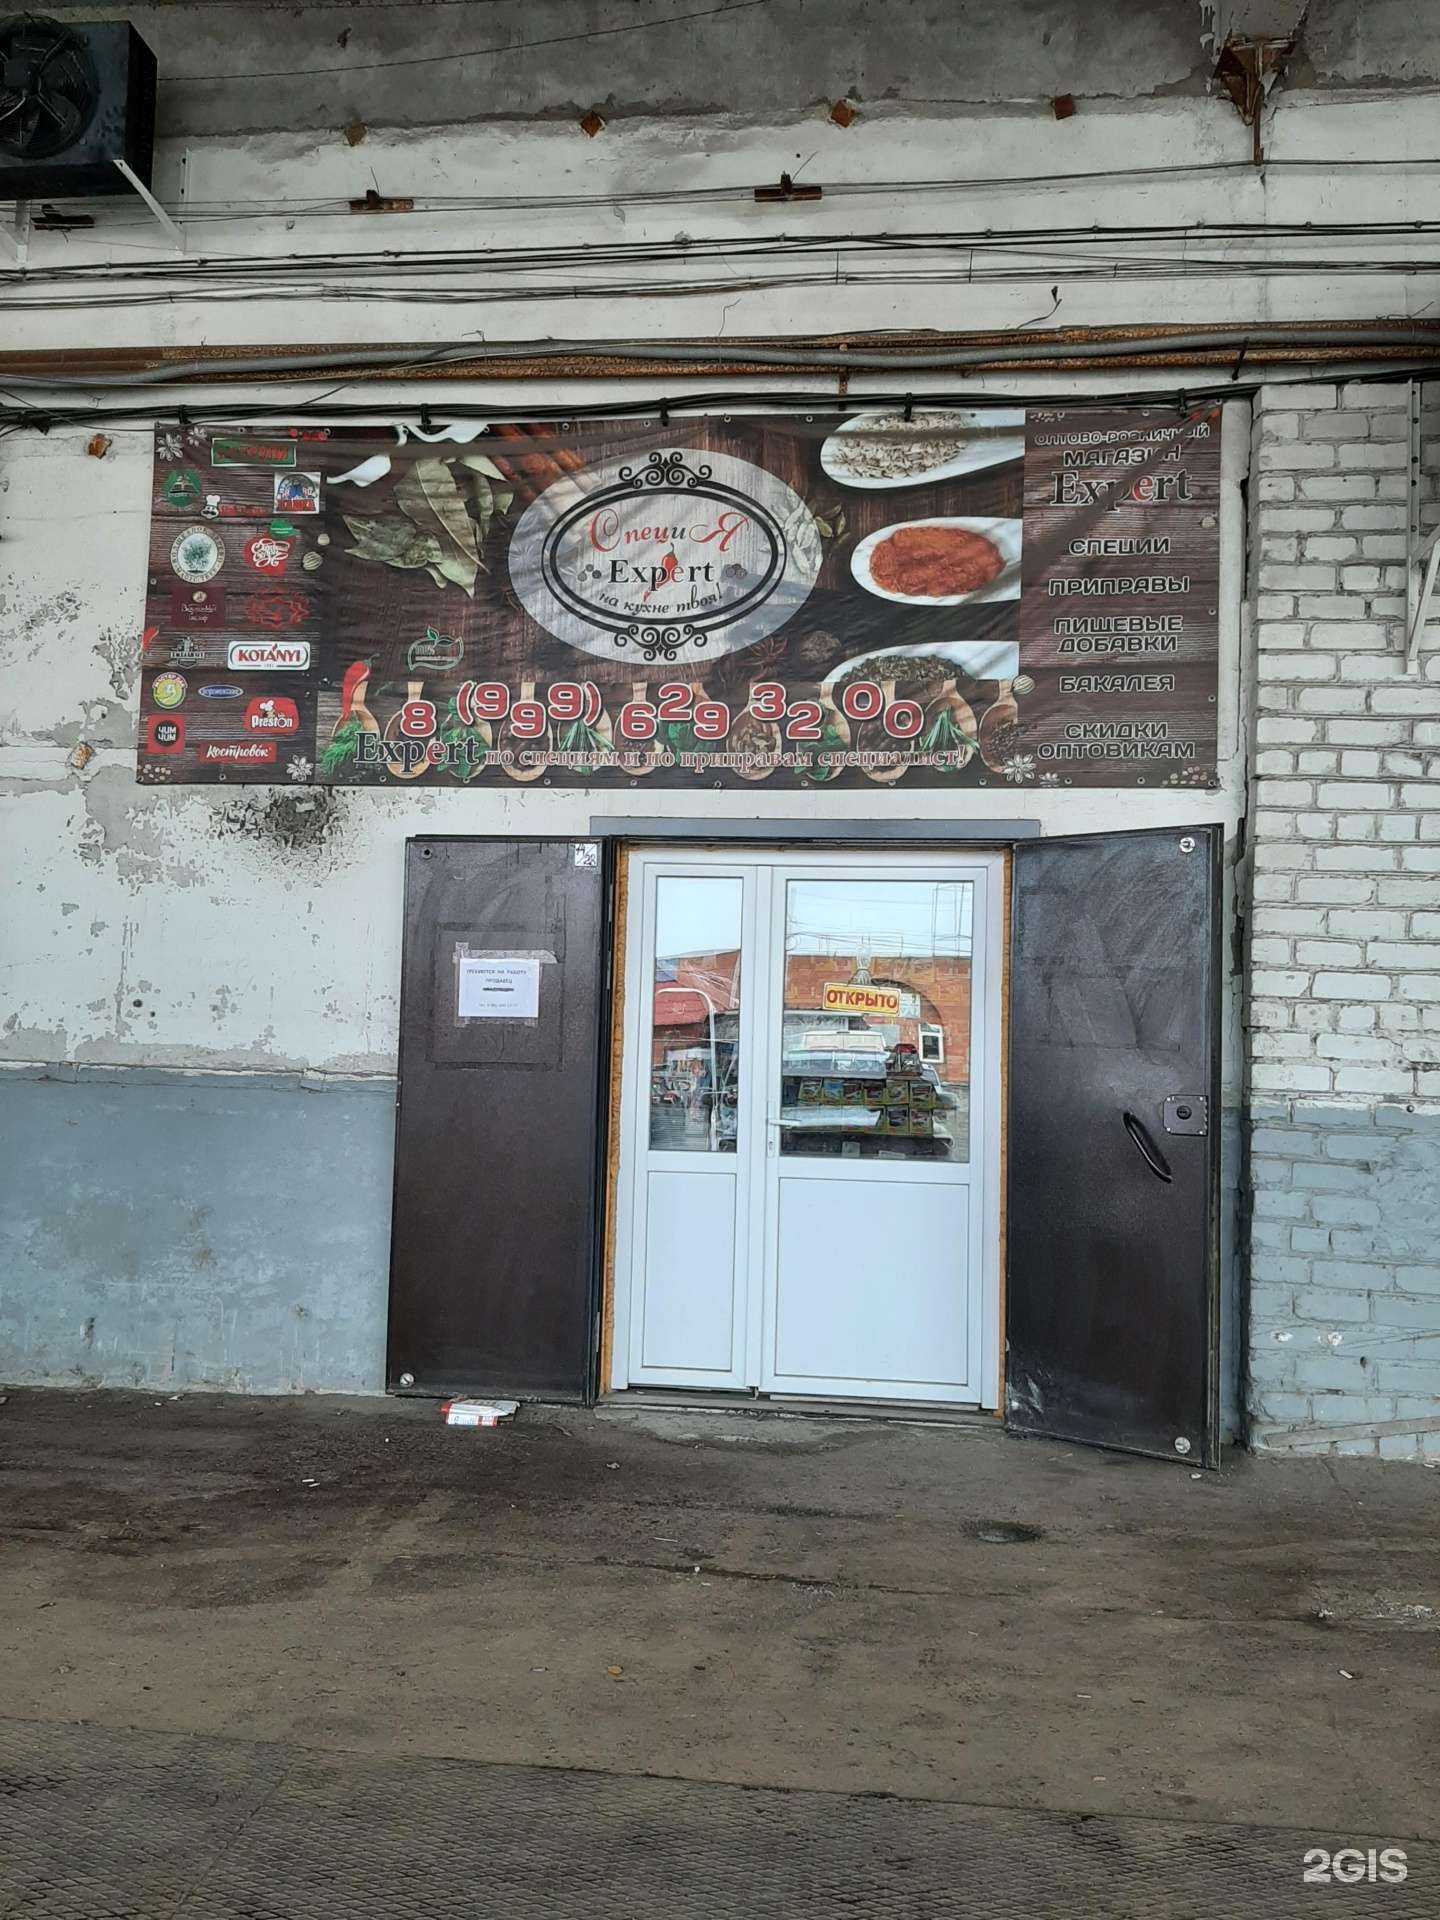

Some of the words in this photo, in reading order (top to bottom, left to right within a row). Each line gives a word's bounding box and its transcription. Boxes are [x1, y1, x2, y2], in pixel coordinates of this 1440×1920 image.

[1034, 422, 1211, 446] ОПТОВО-РОЗНИЧЙ
[1050, 468, 1192, 513] Expert
[1069, 538, 1170, 556] СПЕЦИИ
[608, 559, 715, 591] Expert
[1049, 576, 1190, 597] ПРИПРАВЫ
[599, 593, 618, 608] на
[623, 601, 670, 616] кухне
[676, 584, 722, 614] твоя!
[1054, 616, 1183, 635] ПИЩЕВЫЕ
[1057, 635, 1178, 654] ДОБАВКИ
[1059, 674, 1175, 693] БАКАЛЕЯ
[400, 700, 437, 738] 8
[457, 680, 602, 739] (999)
[620, 682, 730, 740] 629
[750, 682, 823, 740] 32
[842, 681, 925, 739] 00
[1065, 723, 1168, 741] СКИДКИ
[353, 731, 480, 773] Expert
[486, 750, 513, 767] по
[518, 749, 618, 770] специям
[624, 750, 641, 767] и
[645, 750, 675, 767] по
[679, 750, 815, 773] приправам
[817, 745, 967, 769] специалист!
[1037, 742, 1195, 760] ОПТОВИКАМ
[827, 989, 896, 1009] ОТКРЫТО
